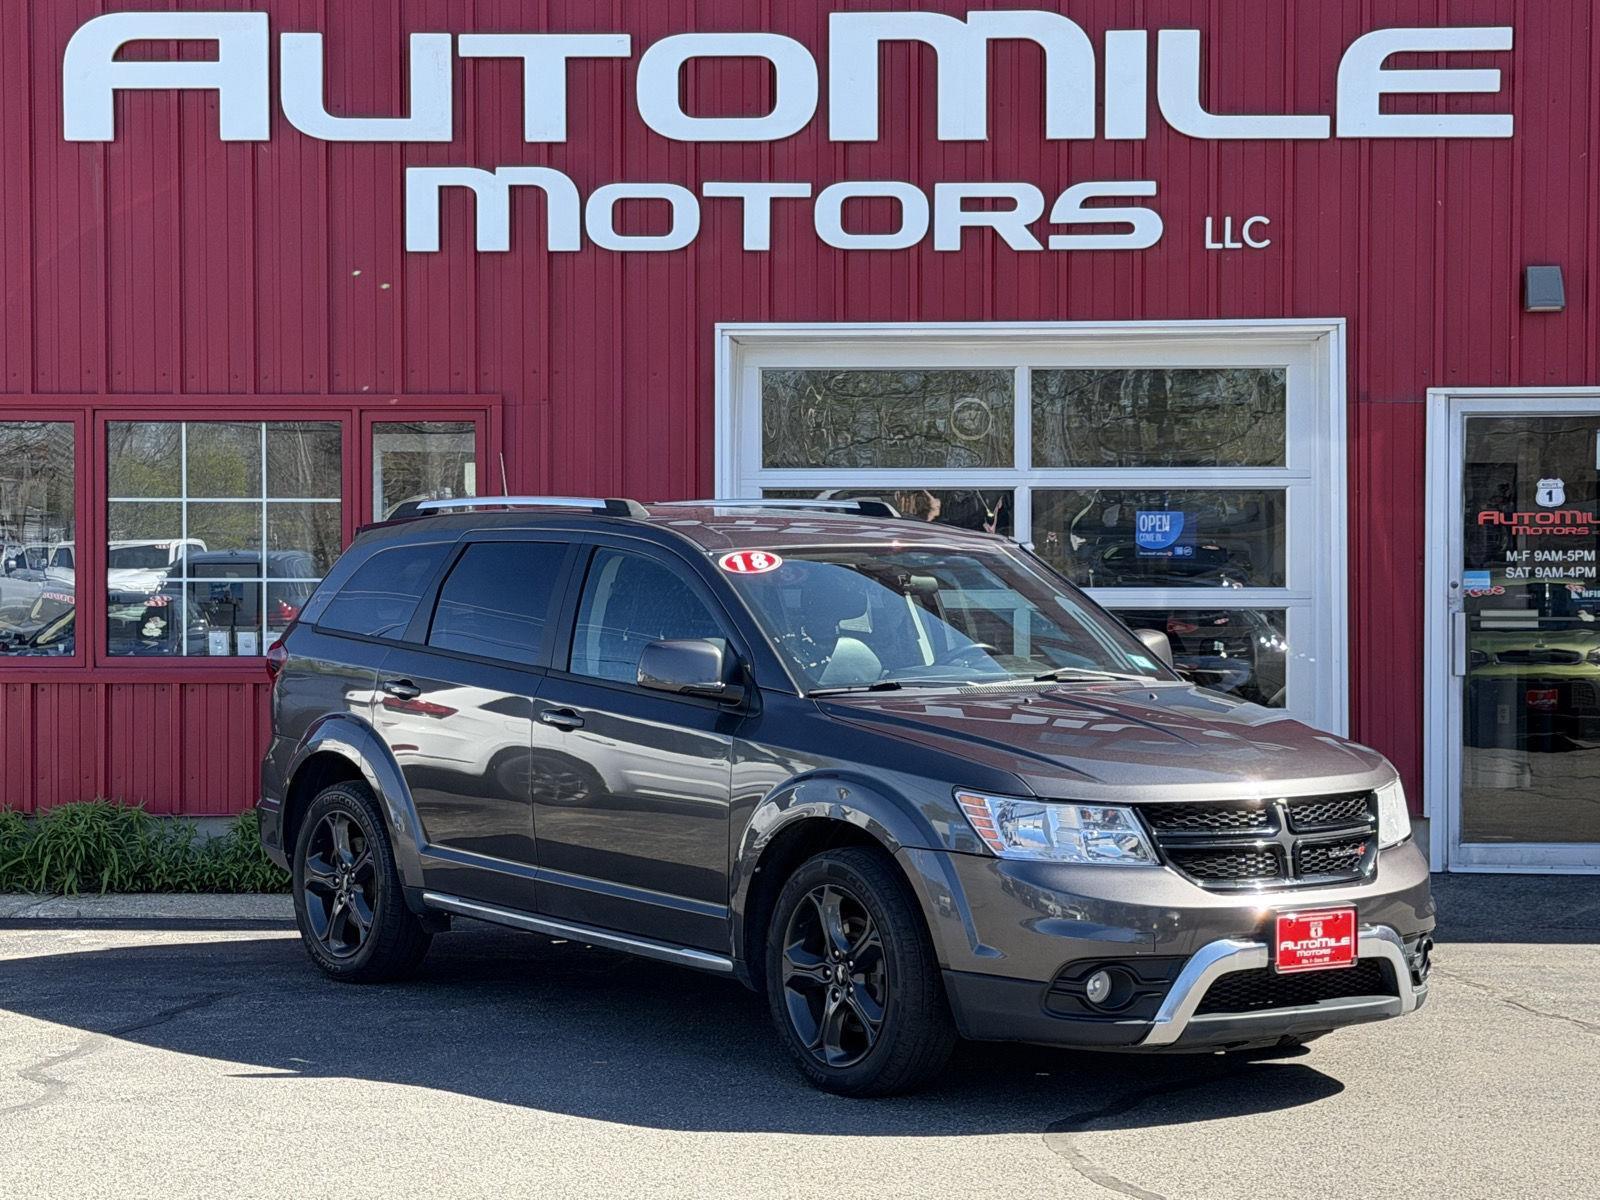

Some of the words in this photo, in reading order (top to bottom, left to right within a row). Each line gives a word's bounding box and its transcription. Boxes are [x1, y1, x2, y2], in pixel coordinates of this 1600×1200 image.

[406, 166, 1163, 252] MOTORS
[1205, 215, 1271, 249] LLC
[1545, 489, 1553, 503] 1
[1139, 514, 1171, 532] OPEN
[1478, 510, 1600, 526] AUTOMIL
[731, 552, 769, 572] 18
[1506, 550, 1531, 561] M-F
[1534, 550, 1596, 561] 9AM-5PM
[1505, 567, 1532, 578] SAT
[1534, 566, 1597, 578] 9AM-4PM
